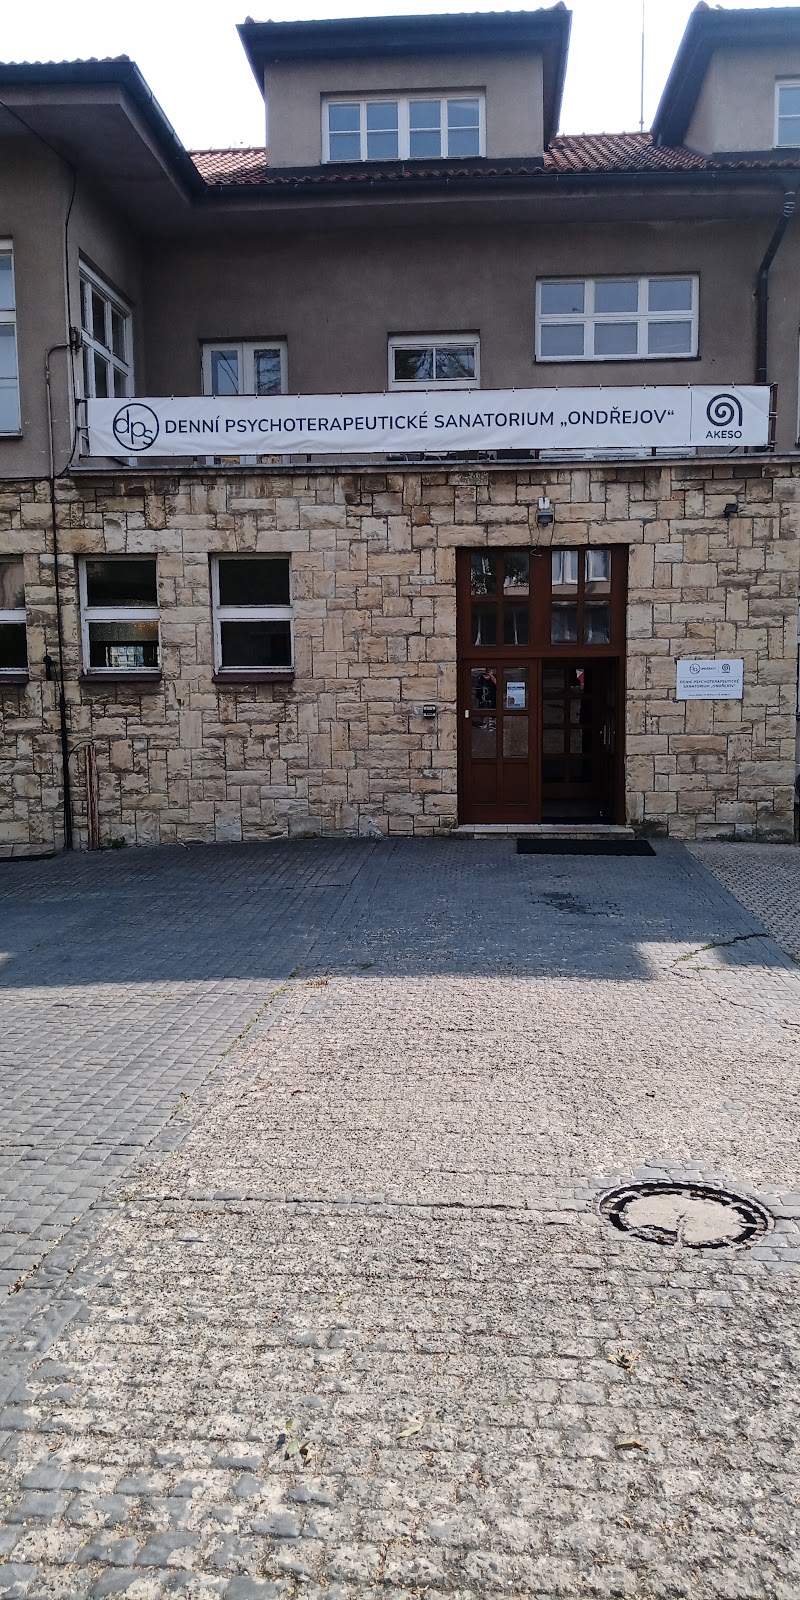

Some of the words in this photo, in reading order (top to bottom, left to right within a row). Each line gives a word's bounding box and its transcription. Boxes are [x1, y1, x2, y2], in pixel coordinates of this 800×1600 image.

[113, 408, 155, 447] dps
[165, 415, 220, 434] DENNÍ
[225, 410, 428, 433] PSYCHOTERAPEUTICKÉ
[434, 411, 554, 429] SANATORIUM
[705, 430, 743, 439] AKESO
